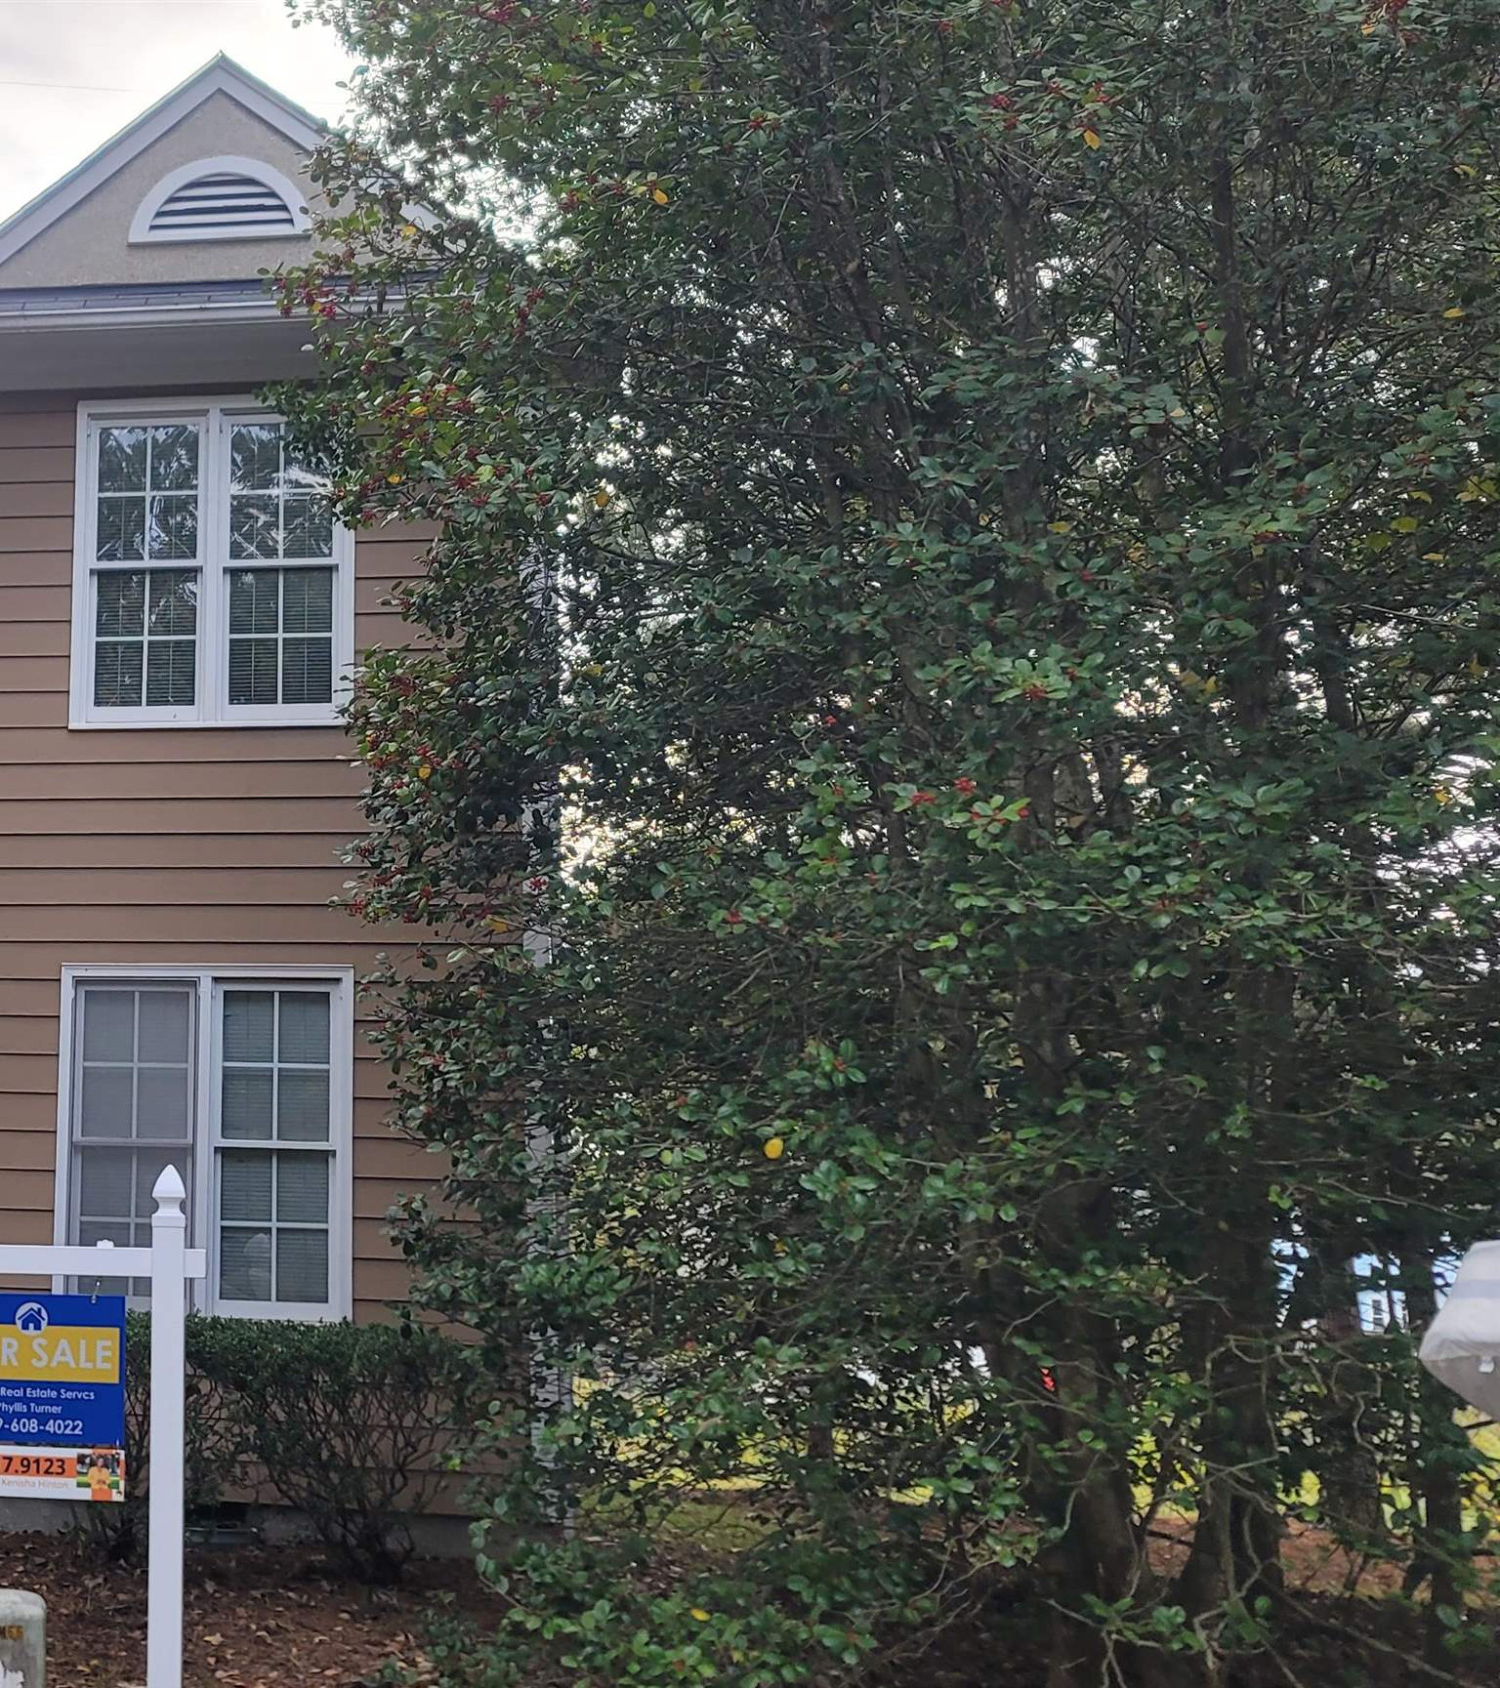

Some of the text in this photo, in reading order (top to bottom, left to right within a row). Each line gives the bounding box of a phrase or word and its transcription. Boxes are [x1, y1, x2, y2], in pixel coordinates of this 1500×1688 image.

[31, 1338, 112, 1370] SALE
[0, 1386, 24, 1397] Real
[26, 1387, 58, 1399] Estate
[60, 1388, 95, 1400] Servcs
[30, 1403, 62, 1414] Turner
